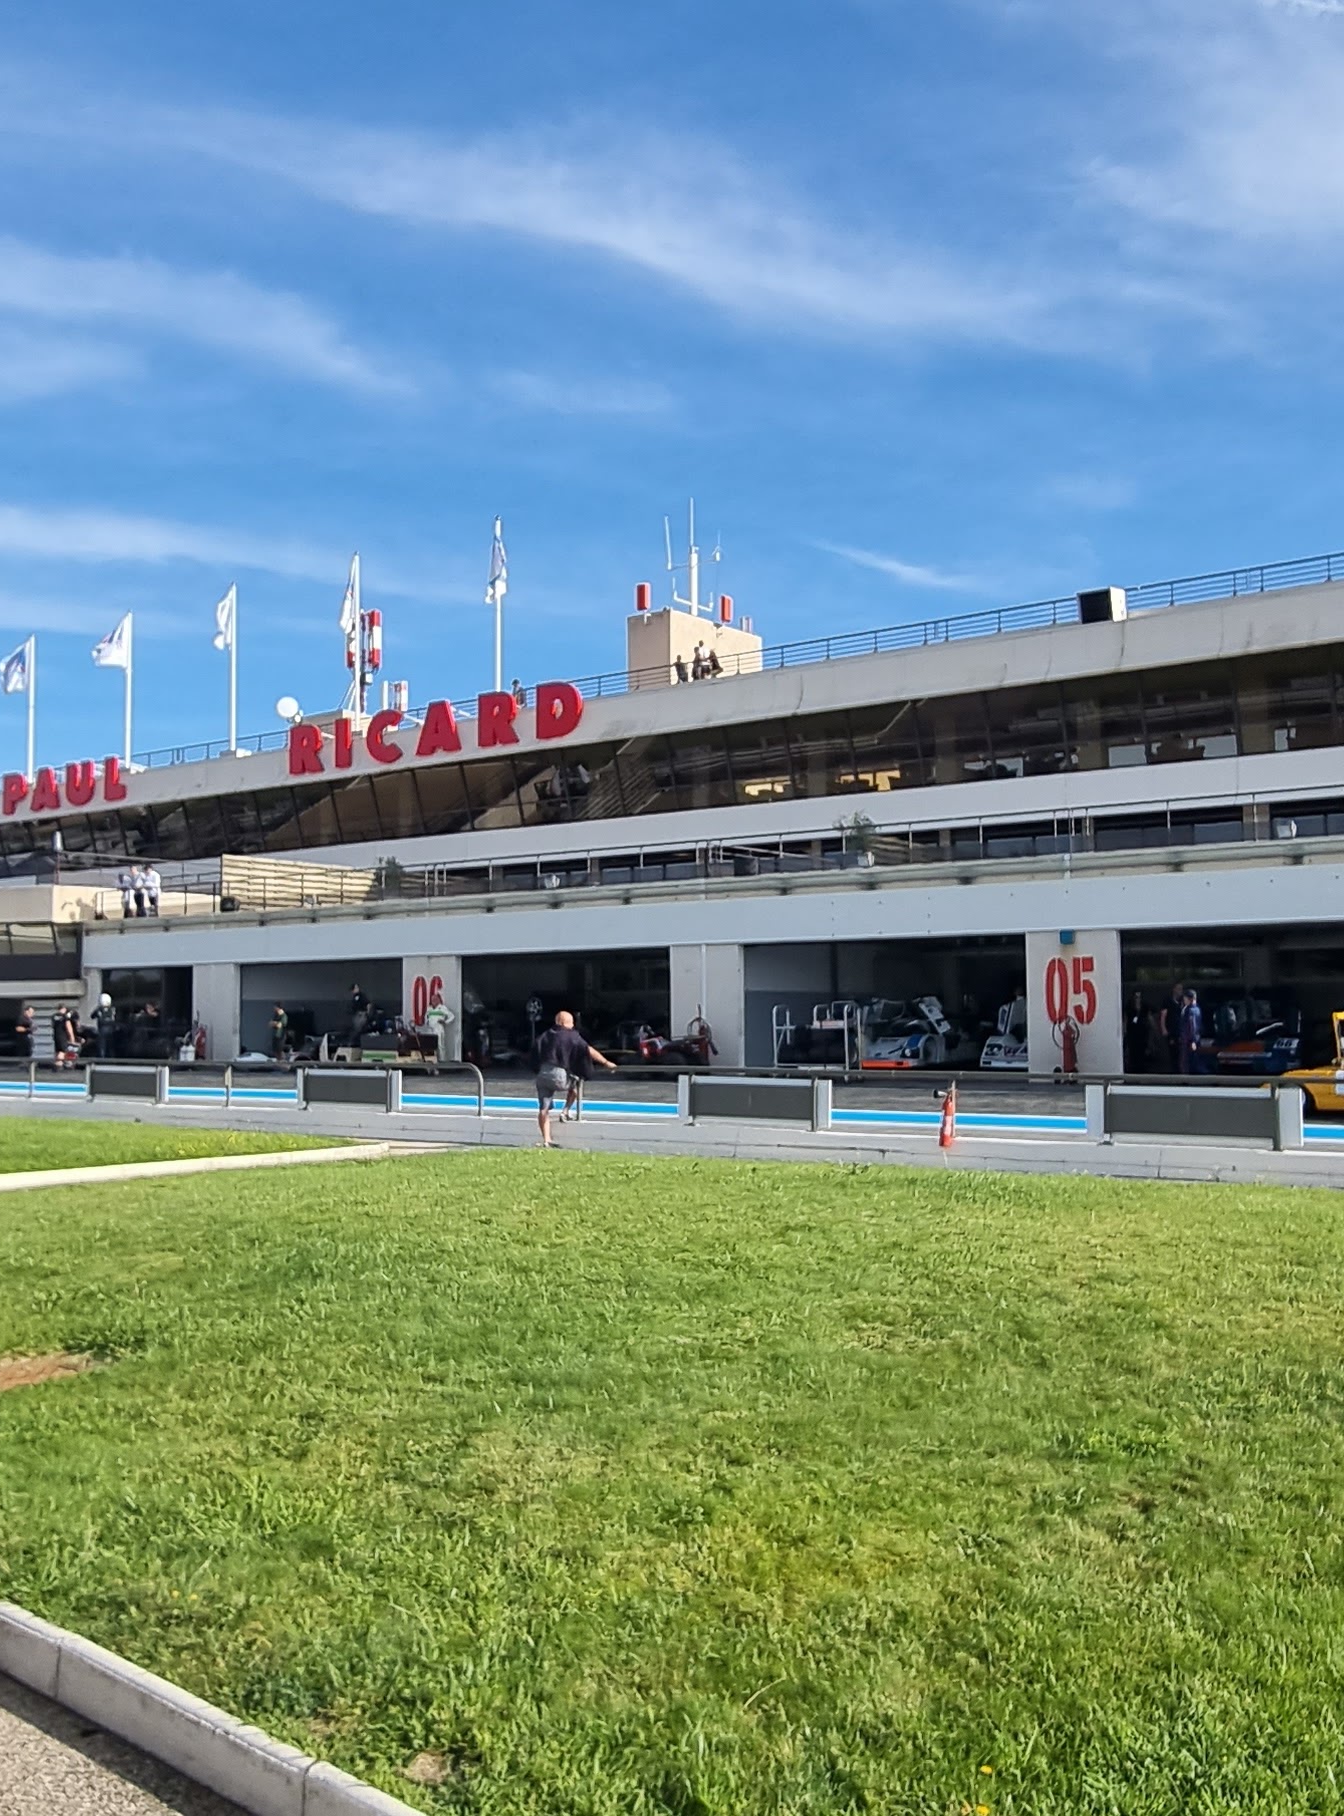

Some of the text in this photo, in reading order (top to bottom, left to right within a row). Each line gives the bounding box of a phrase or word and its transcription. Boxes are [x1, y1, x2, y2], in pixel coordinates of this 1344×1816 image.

[3, 682, 583, 815] PAUL RICARD
[1046, 957, 1096, 1024] 05
